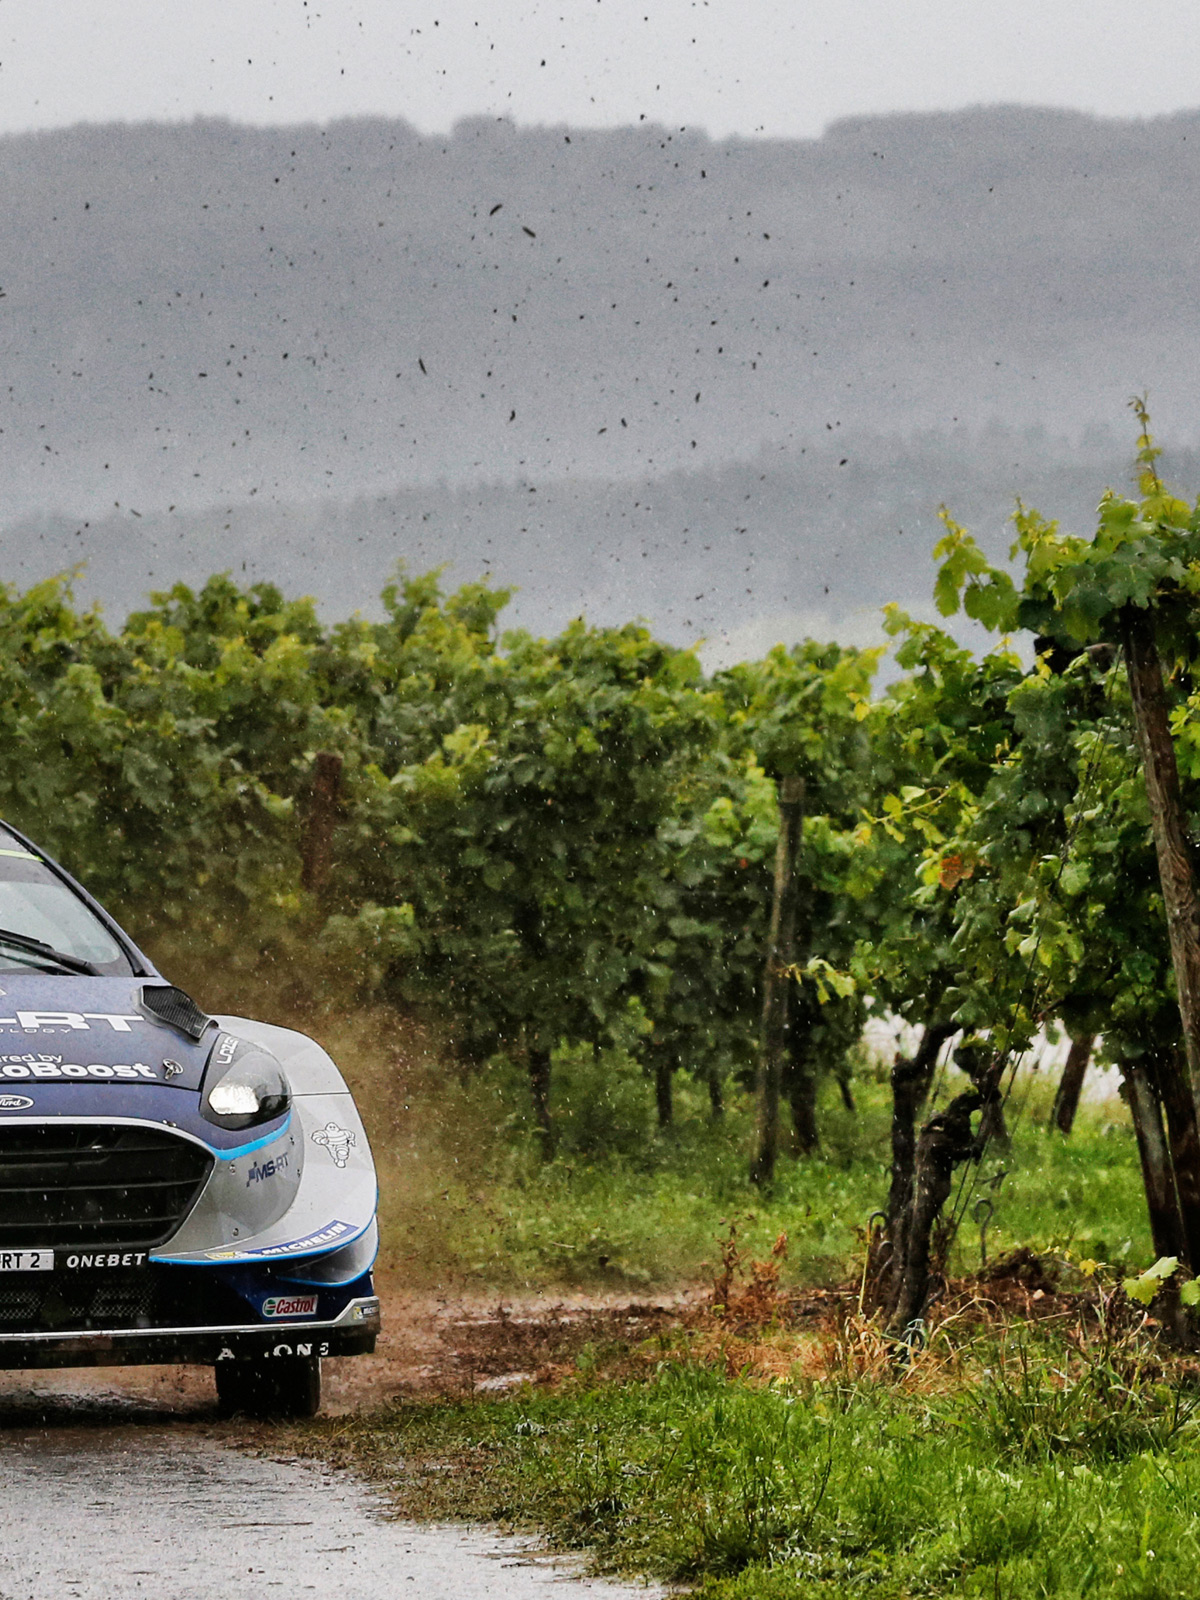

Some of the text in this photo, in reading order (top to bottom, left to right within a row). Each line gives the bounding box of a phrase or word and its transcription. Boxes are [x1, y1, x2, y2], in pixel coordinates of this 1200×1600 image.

[37, 1053, 63, 1064] by
[261, 1221, 348, 1256] MICHELIN
[30, 1252, 41, 1269] 2
[66, 1253, 146, 1270] ONEBET
[275, 1298, 316, 1314] Castrol
